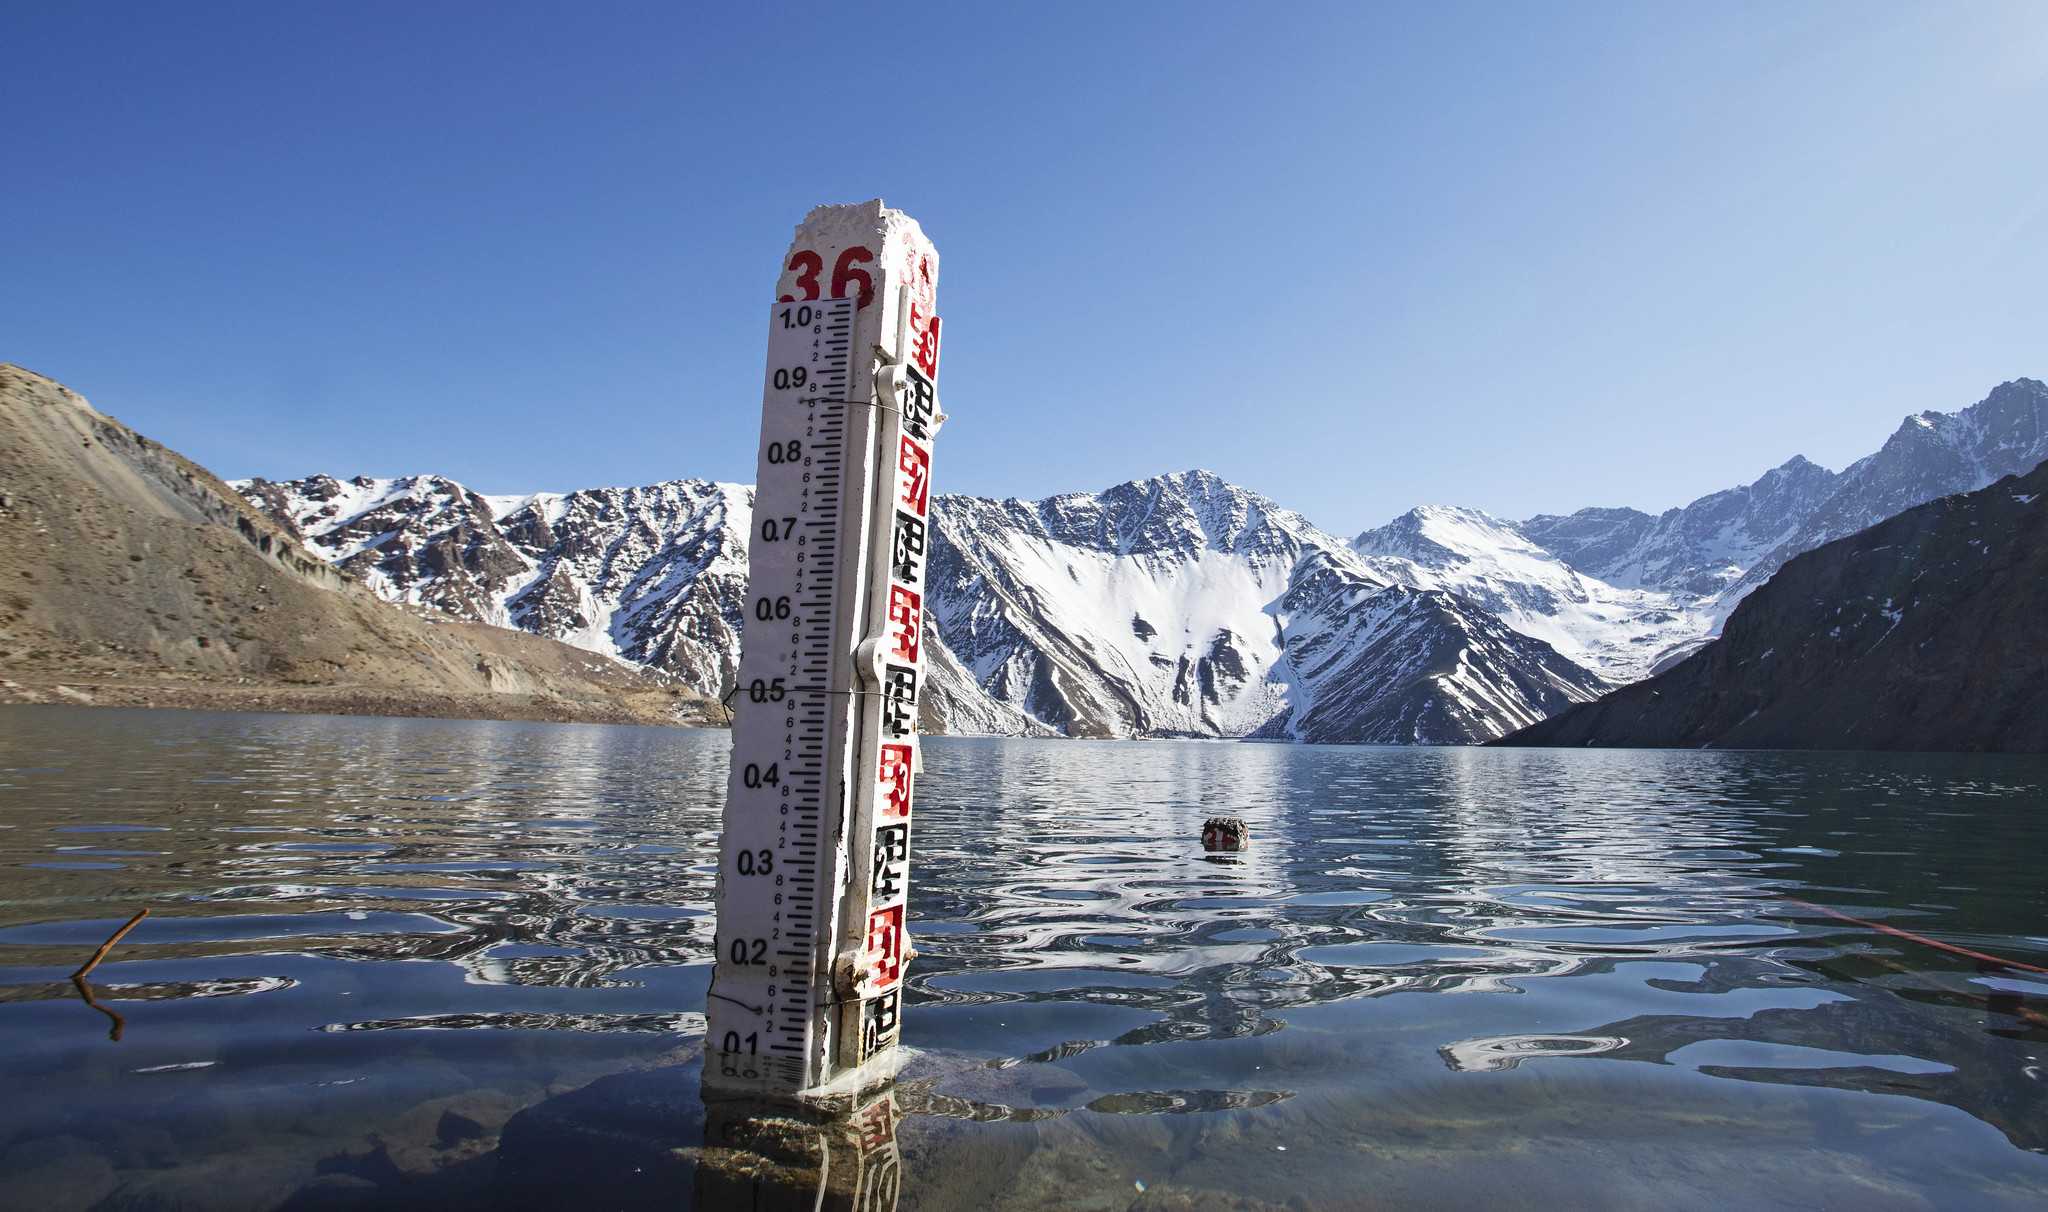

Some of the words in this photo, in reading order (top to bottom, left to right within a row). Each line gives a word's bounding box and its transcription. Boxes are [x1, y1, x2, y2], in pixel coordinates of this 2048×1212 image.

[779, 246, 875, 311] 36
[780, 306, 812, 328] 1.0
[815, 310, 822, 319] 8
[814, 325, 821, 334] 6
[813, 339, 819, 348] 4
[812, 352, 818, 361] 2
[774, 367, 807, 390] 0.9
[810, 383, 816, 392] 8
[808, 413, 813, 422] 4
[807, 426, 813, 436] 2
[768, 440, 801, 464] 0.8
[804, 457, 811, 466] 8
[803, 473, 810, 482] 6
[802, 488, 808, 498] 4
[802, 502, 807, 512] 2
[762, 517, 797, 544] 0.7
[799, 536, 805, 545] 8
[797, 552, 804, 563] 6
[797, 568, 802, 578] 4
[796, 583, 802, 593] 2
[756, 596, 791, 621] 0.6
[793, 616, 800, 627] 8
[792, 633, 799, 644] 6
[792, 650, 797, 660] 4
[790, 665, 797, 676] 2
[750, 678, 785, 703] 0.5
[787, 699, 795, 710] 8
[786, 717, 794, 728] 6
[786, 734, 791, 744] 4
[785, 749, 791, 760] 2
[744, 763, 780, 789] 0.4
[782, 785, 789, 796] 8
[780, 803, 788, 815] 6
[780, 821, 786, 832] 4
[779, 837, 785, 848] 2
[738, 850, 773, 876] 0.3
[776, 874, 783, 886] 8
[775, 893, 782, 905] 6
[774, 912, 779, 922] 4
[773, 928, 779, 940] 2
[731, 939, 768, 966] 0.2
[769, 965, 777, 977] 8
[768, 985, 776, 997] 6
[768, 1003, 773, 1015] 4
[766, 1020, 773, 1032] 2
